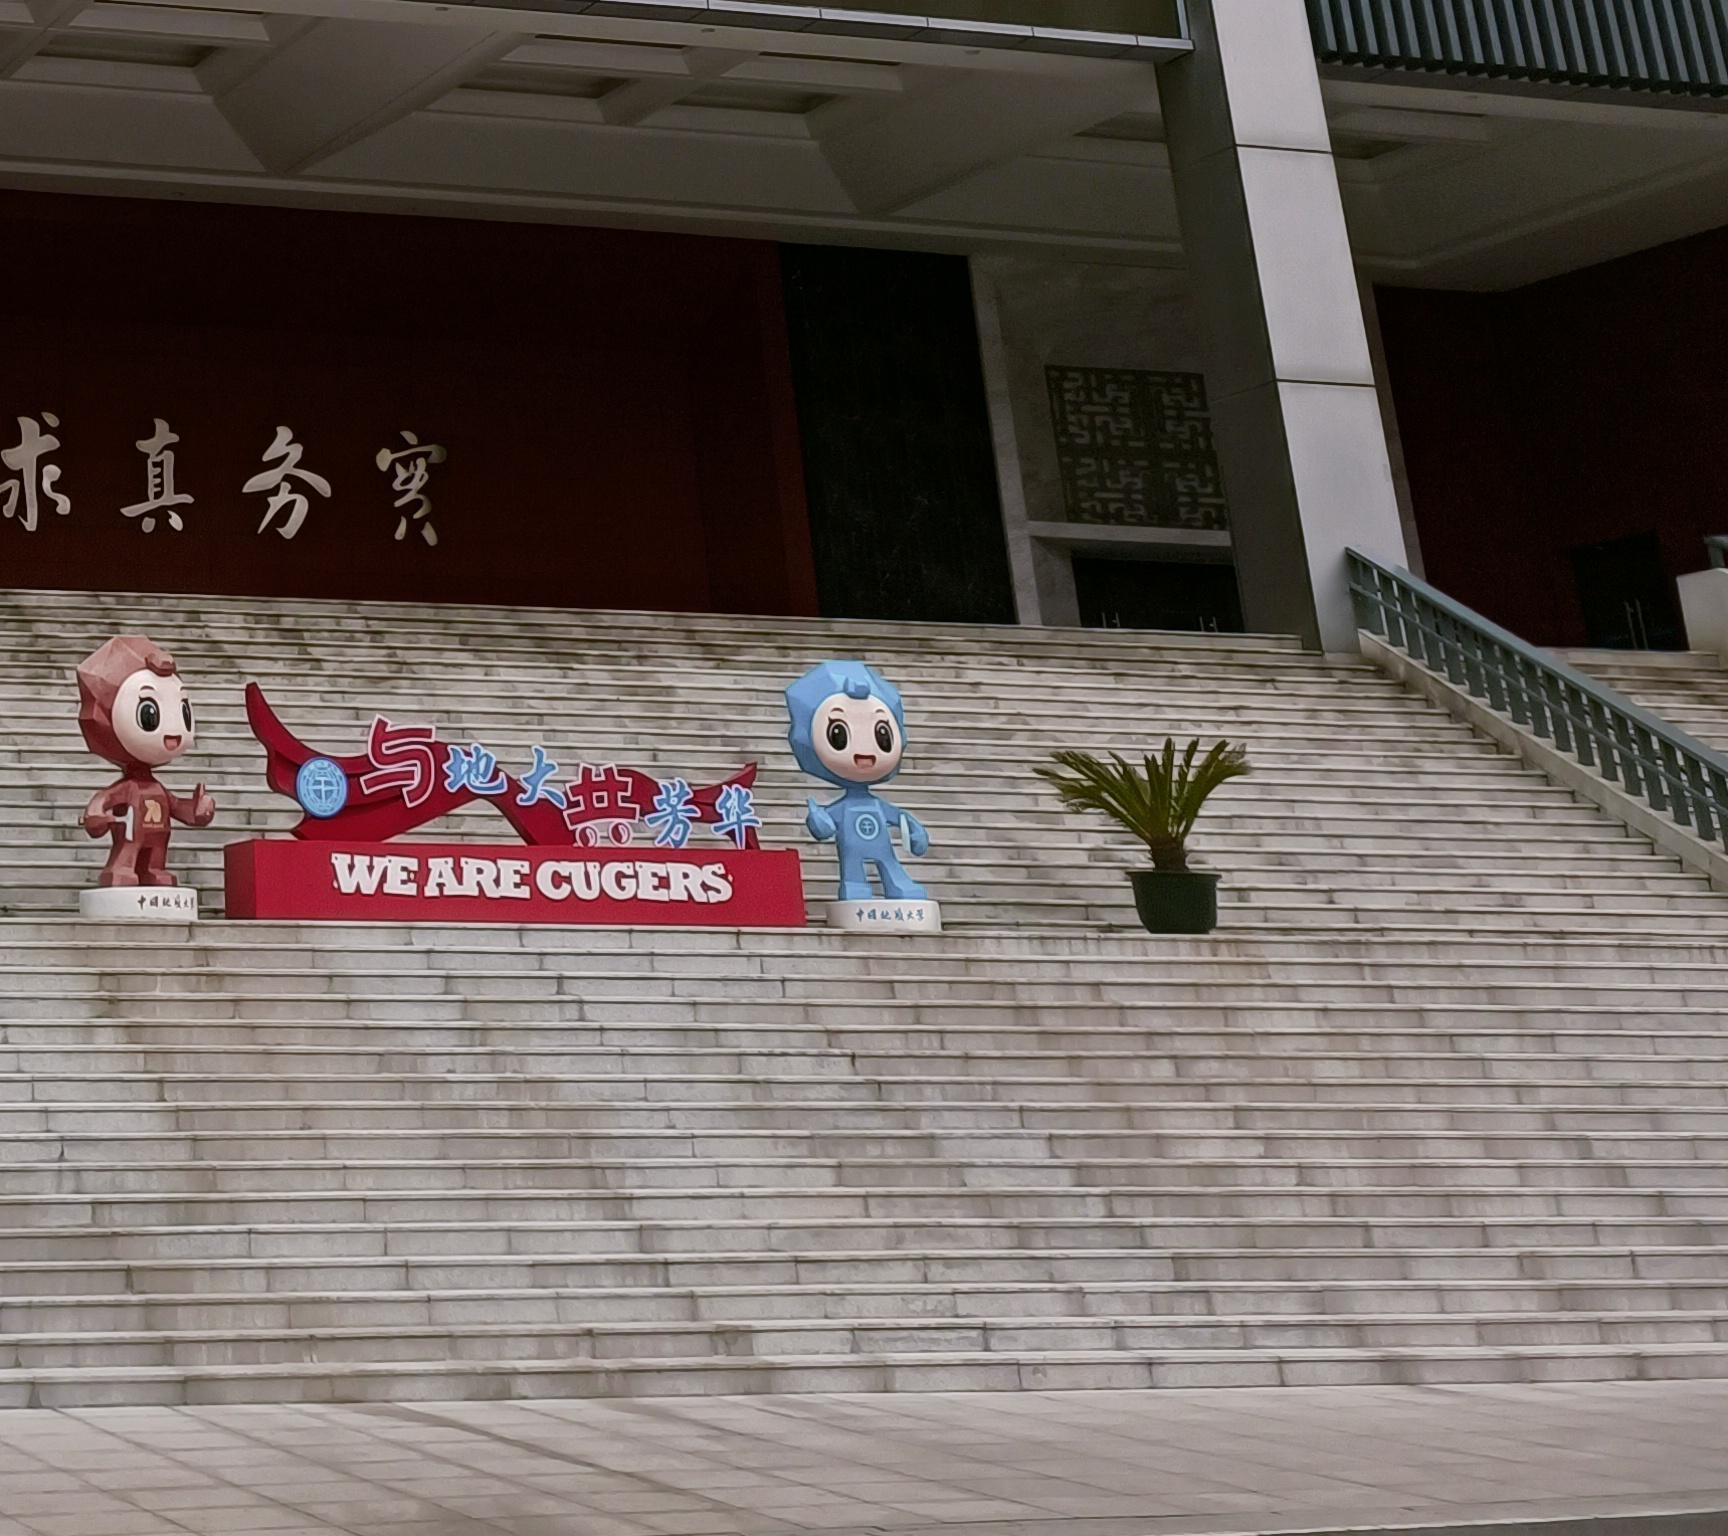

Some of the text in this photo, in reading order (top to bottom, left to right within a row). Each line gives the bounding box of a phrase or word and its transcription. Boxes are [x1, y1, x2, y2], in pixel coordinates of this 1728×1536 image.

[360, 714, 763, 849] 与地大共芳华
[331, 853, 734, 904] WE ARE CUGERS
